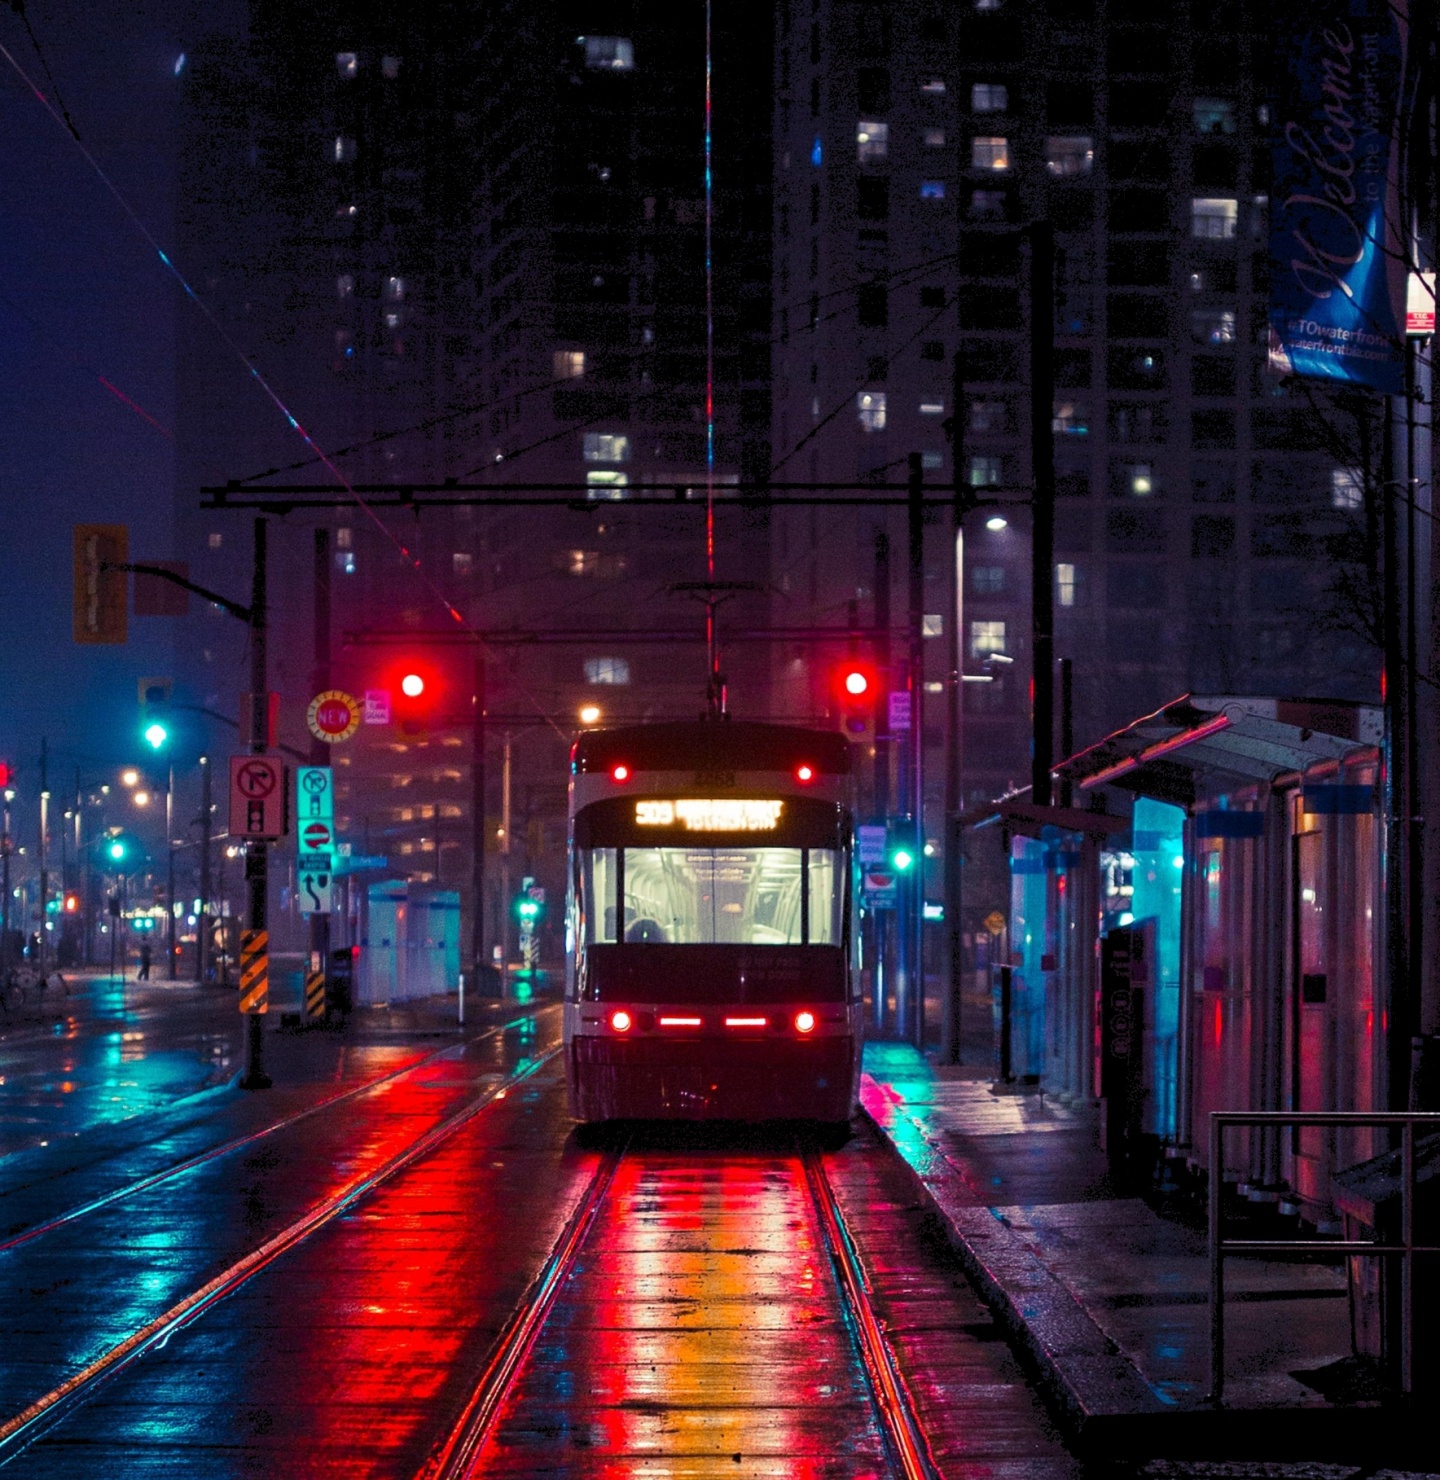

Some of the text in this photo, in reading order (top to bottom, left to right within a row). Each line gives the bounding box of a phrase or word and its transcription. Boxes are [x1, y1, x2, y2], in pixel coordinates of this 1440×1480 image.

[1282, 17, 1364, 298] Welcome
[1363, 143, 1381, 174] the
[1364, 181, 1381, 202] to
[319, 708, 349, 725] NEW
[636, 801, 674, 825] 509
